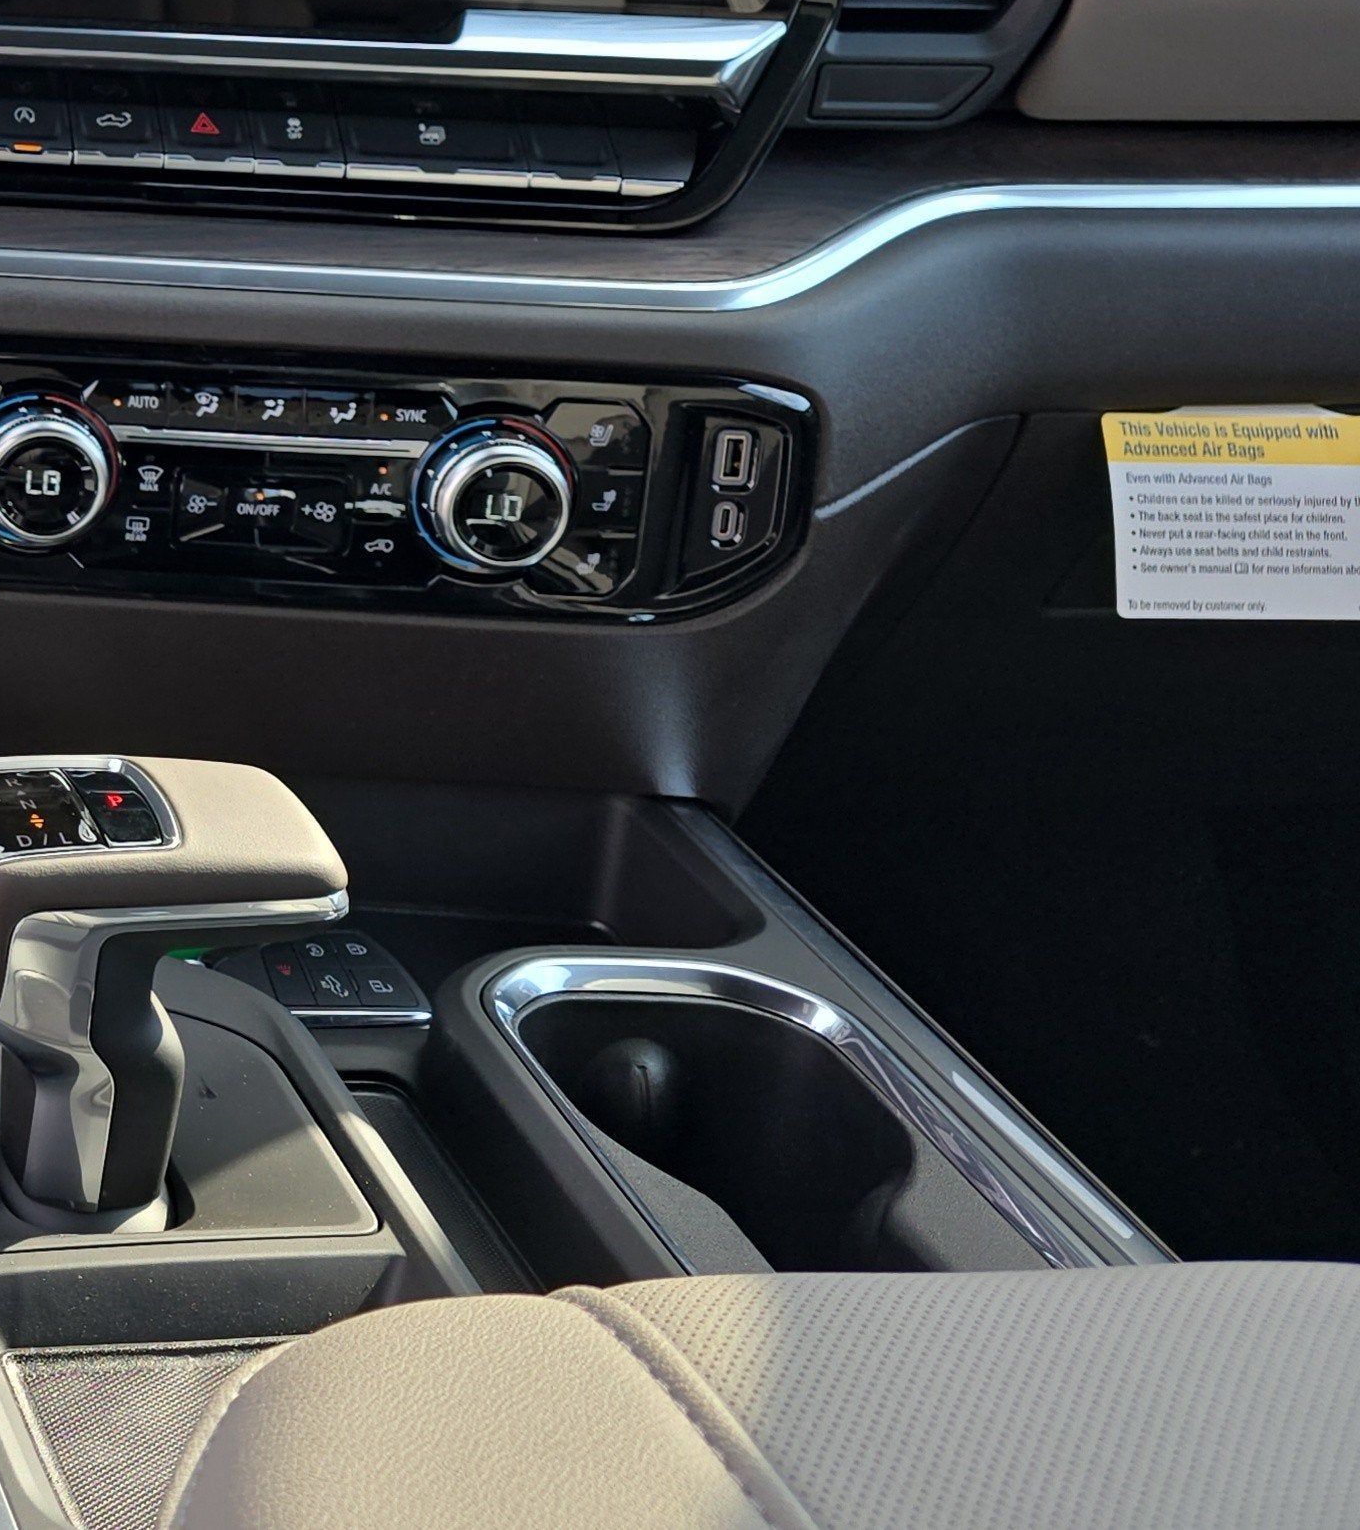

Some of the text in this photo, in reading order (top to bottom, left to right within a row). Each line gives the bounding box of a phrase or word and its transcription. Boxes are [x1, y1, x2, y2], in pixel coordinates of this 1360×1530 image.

[128, 395, 159, 409] AUTO
[395, 408, 427, 423] SYNC
[1120, 421, 1339, 441] This Vehicle is Equipped with
[1124, 441, 1265, 461] Advanced Air Bags
[1126, 472, 1272, 488] Even with Advanced Air Bags
[370, 483, 393, 495] A/C
[1137, 493, 1178, 505] Children
[1180, 495, 1198, 505] can
[1201, 494, 1213, 505] be
[1215, 494, 1242, 505] killed
[1245, 496, 1255, 506] or
[1258, 495, 1301, 509] seriously
[1304, 495, 1338, 509] injured
[1340, 496, 1352, 509] by
[236, 503, 281, 517] ON/OFF
[1138, 510, 1346, 525] The back seat is the safest place for children.
[1139, 528, 1166, 539] Never
[1169, 528, 1184, 541] put
[1194, 528, 1246, 541] rear-facing
[1248, 529, 1271, 540] child
[1273, 529, 1293, 540] seat
[1295, 529, 1304, 540] in
[1306, 530, 1321, 541] the
[1323, 530, 1348, 541] front.
[1139, 545, 1332, 558] Always use seat belts and child restraints.
[1140, 562, 1157, 573] See
[1160, 562, 1196, 573] owner's
[1199, 563, 1232, 573] manual
[1252, 563, 1264, 574] for
[1266, 564, 1290, 575] more
[1292, 563, 1343, 575] information
[1128, 599, 1138, 610] To
[1140, 600, 1151, 610] be
[1153, 600, 1191, 610] removed
[1193, 600, 1202, 612] by
[1205, 601, 1245, 610] customer
[20, 799, 38, 810] N
[107, 794, 124, 807] P
